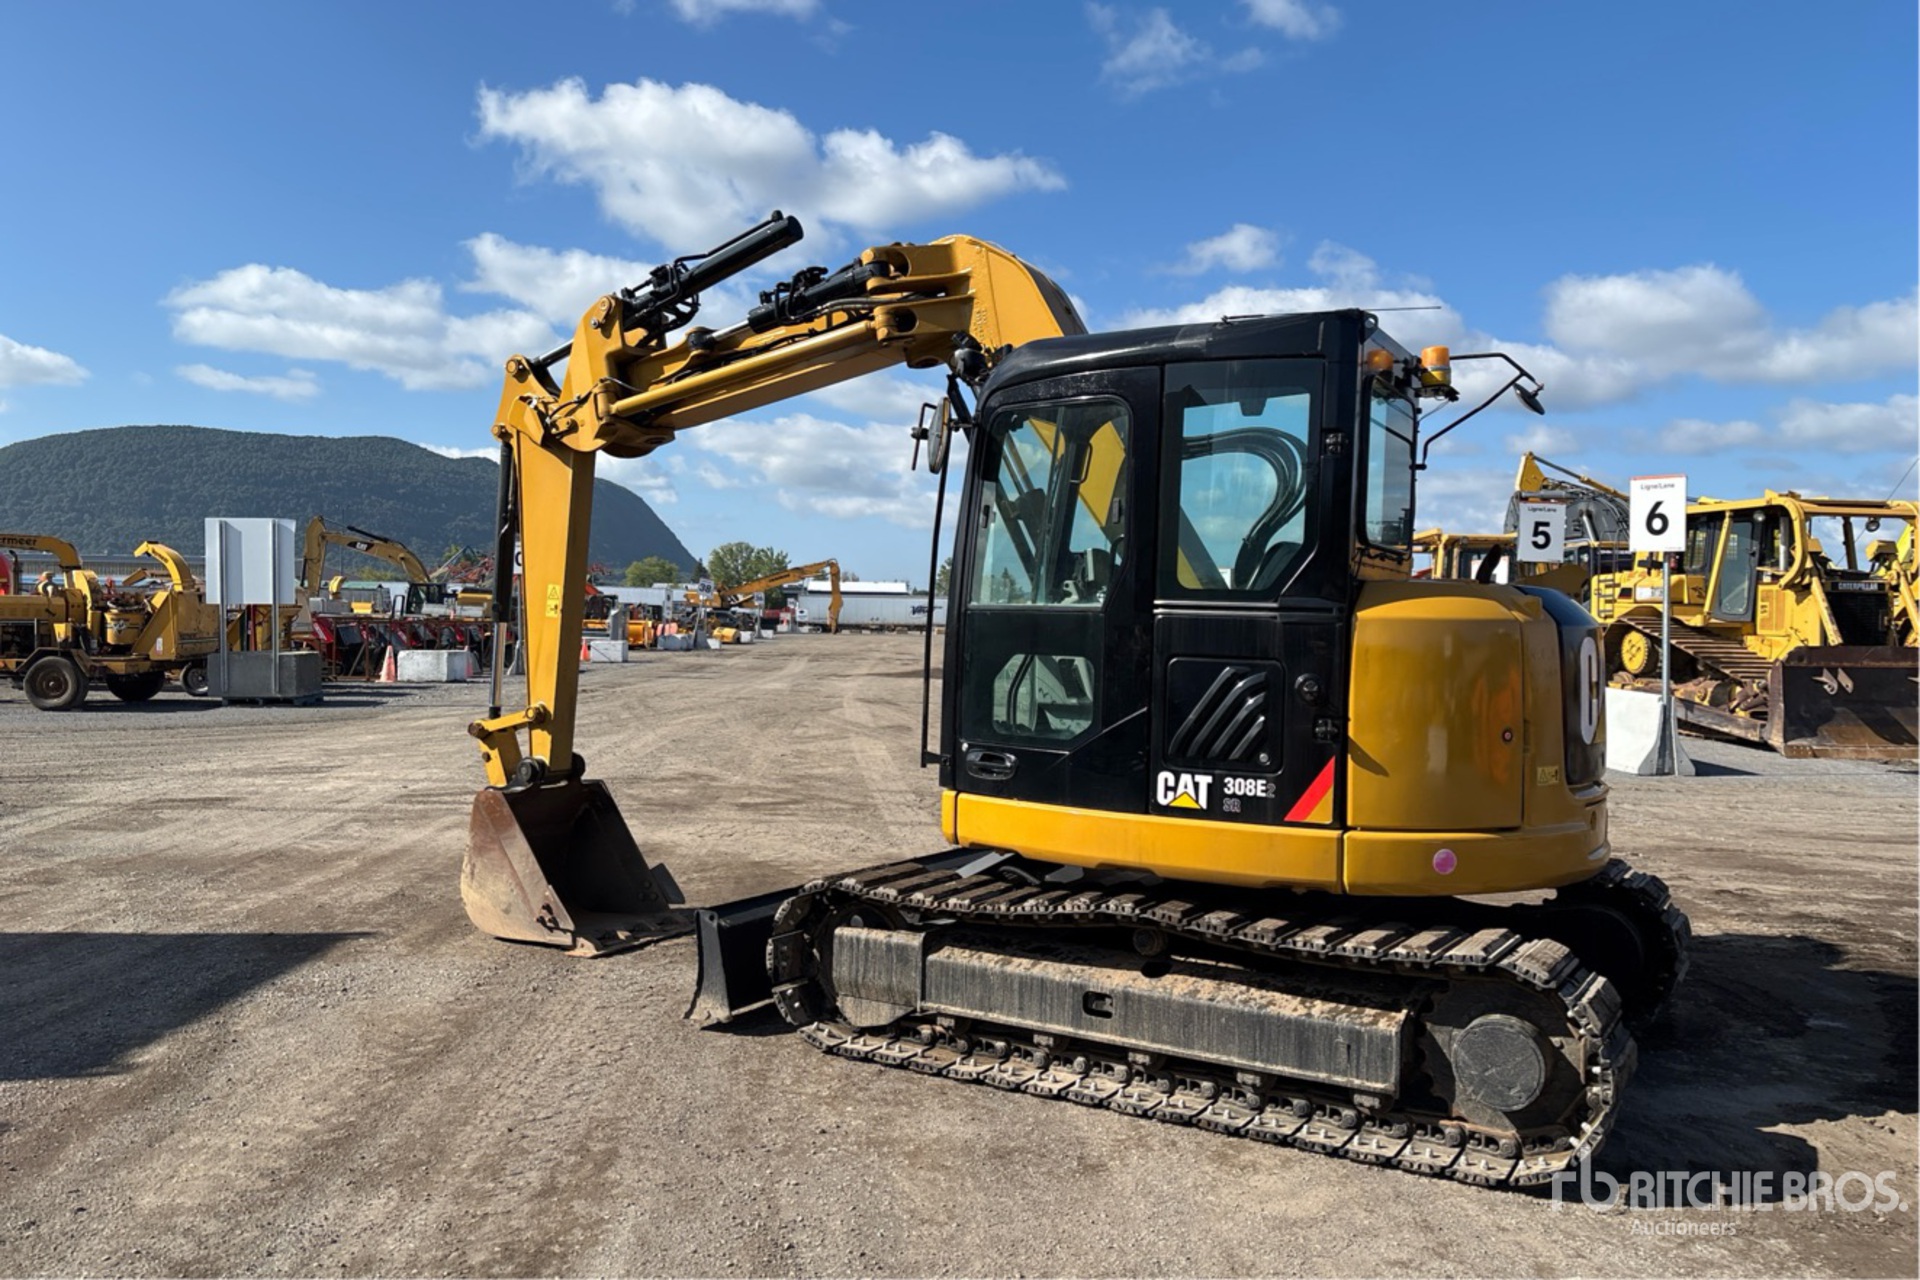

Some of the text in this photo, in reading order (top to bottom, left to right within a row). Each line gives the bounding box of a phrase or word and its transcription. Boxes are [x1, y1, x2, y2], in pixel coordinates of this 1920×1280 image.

[1645, 500, 1669, 536] 6
[1531, 521, 1551, 550] 5
[1156, 771, 1213, 810] CAT
[1223, 798, 1241, 813] SR
